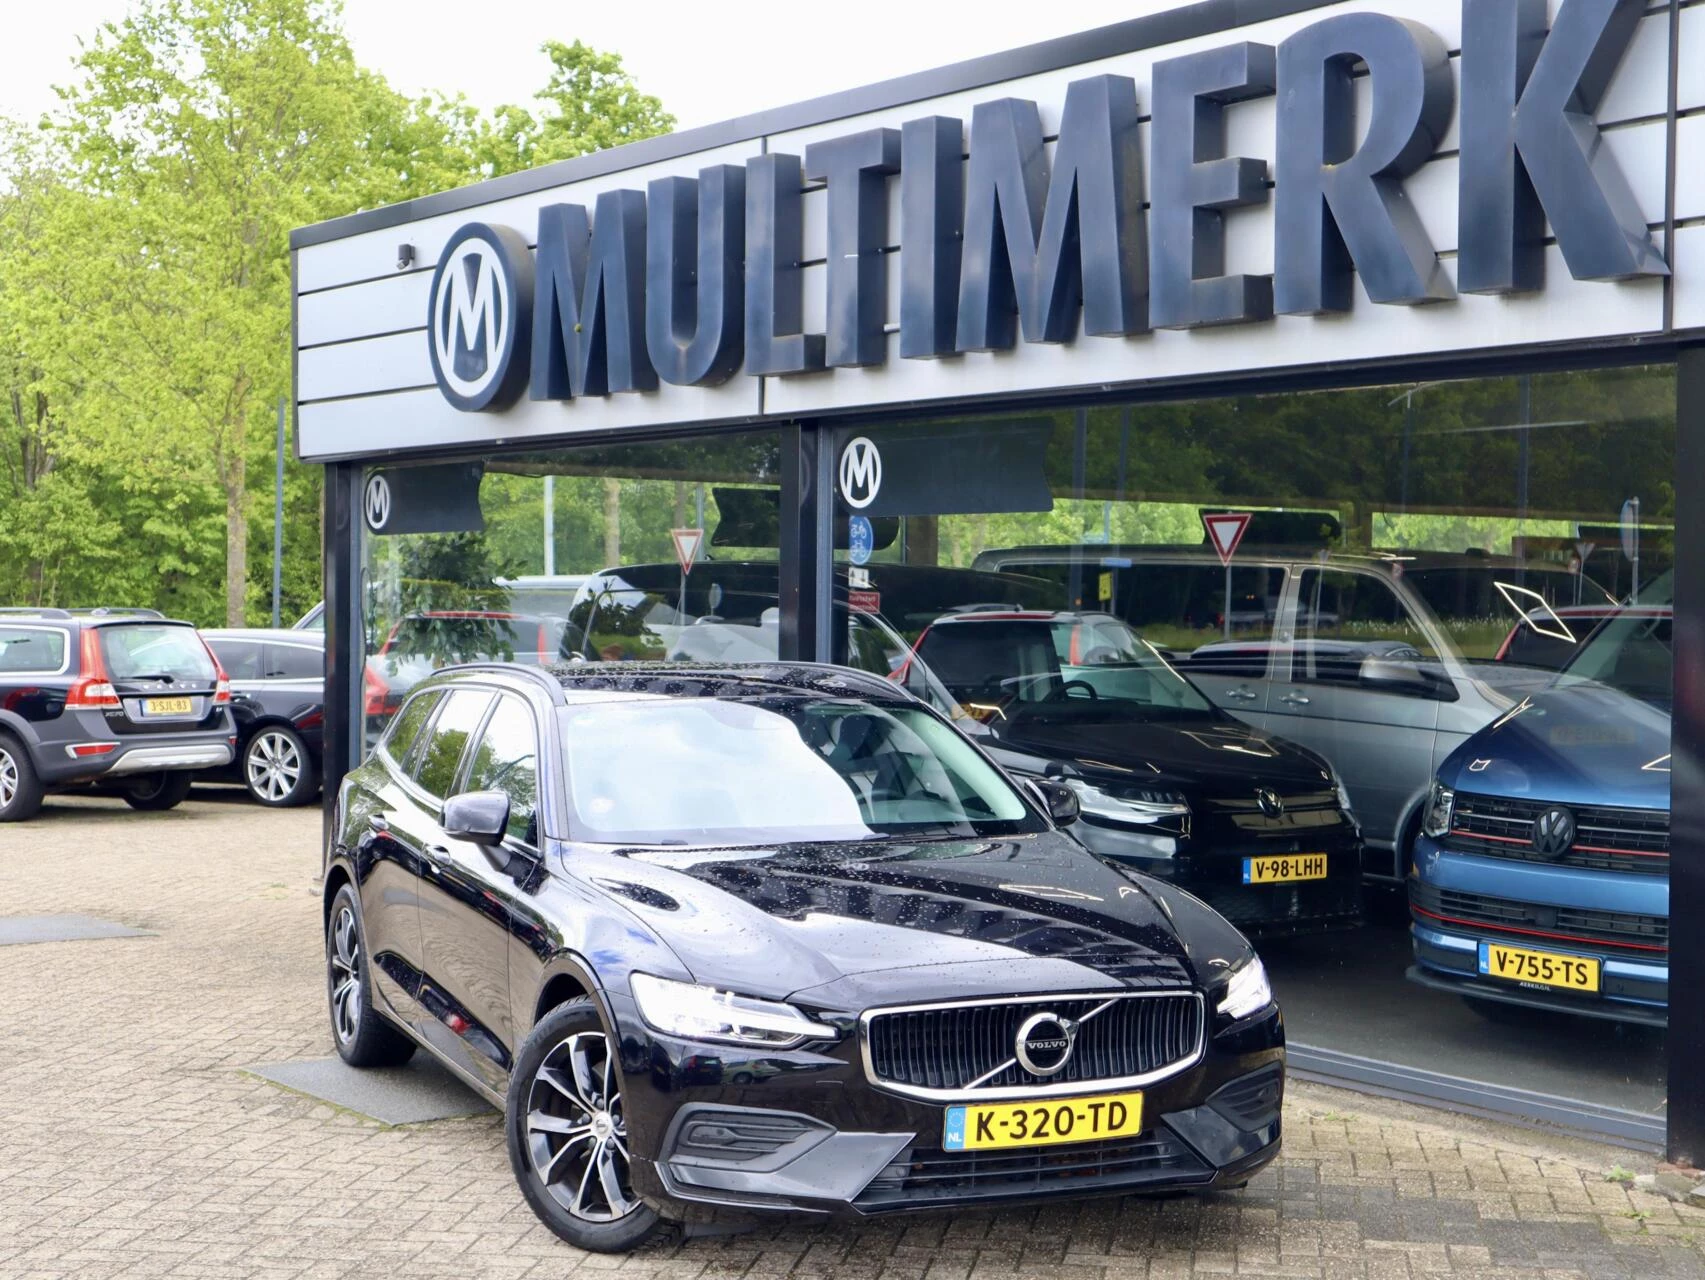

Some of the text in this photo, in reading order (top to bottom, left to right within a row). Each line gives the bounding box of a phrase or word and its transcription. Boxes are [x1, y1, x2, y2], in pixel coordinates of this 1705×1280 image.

[441, 0, 1669, 400] M MULTIMERK
[842, 439, 879, 505] M
[367, 476, 388, 527] M
[151, 699, 187, 711] 3-SJL-83
[1256, 858, 1323, 879] V-98-LHH
[1496, 950, 1588, 985] V-755-TS
[1027, 1040, 1067, 1049] VOLVO
[947, 1101, 1127, 1142] NL K-320-TD
